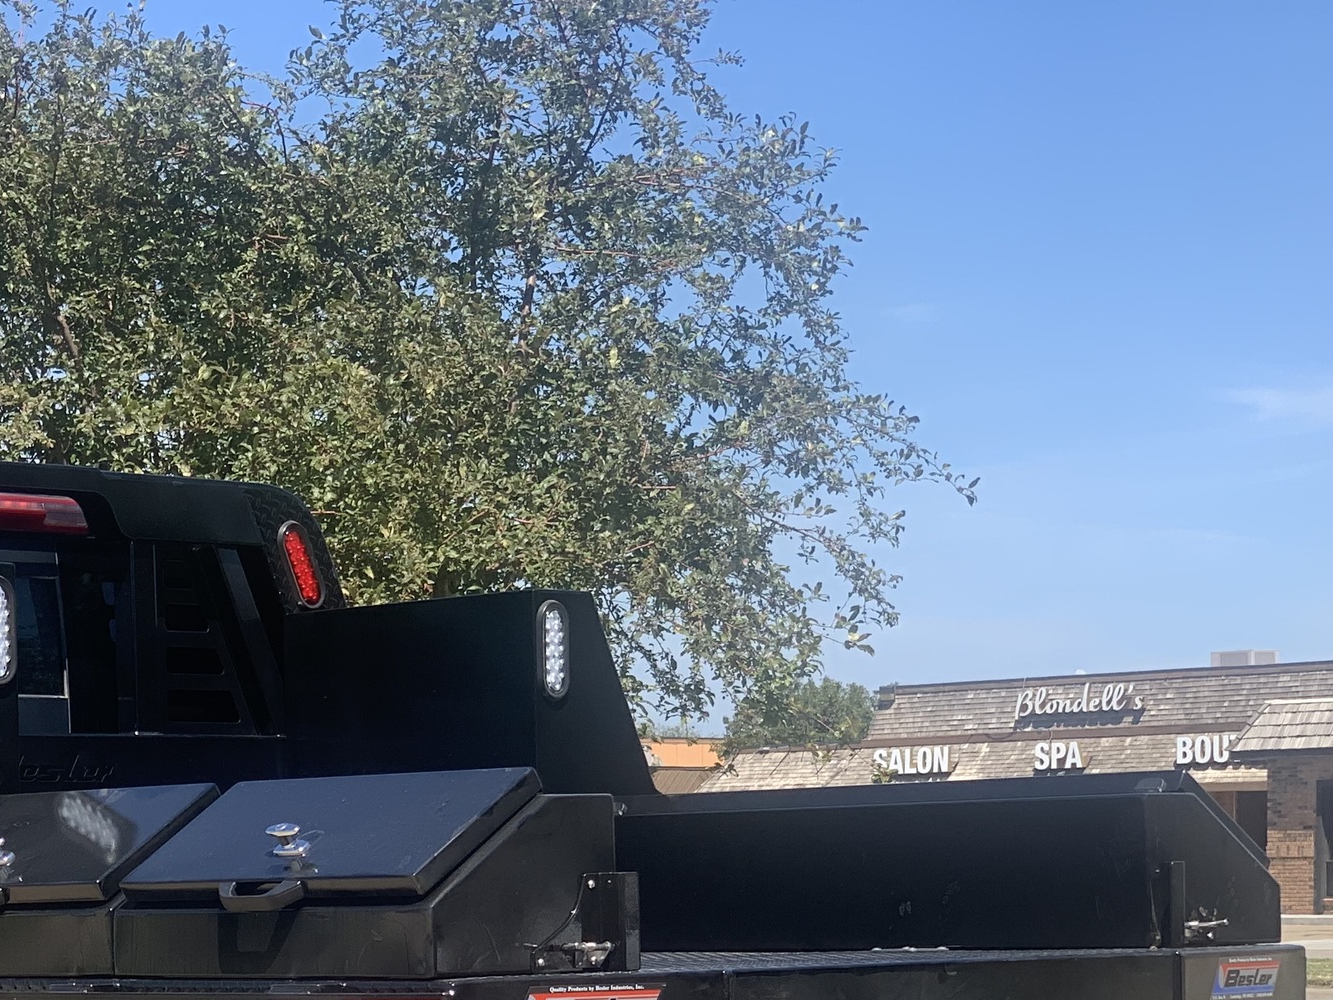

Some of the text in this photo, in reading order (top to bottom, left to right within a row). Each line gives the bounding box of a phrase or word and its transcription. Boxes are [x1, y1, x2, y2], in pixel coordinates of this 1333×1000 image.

[1015, 682, 1144, 720] Blondell's
[873, 746, 950, 775] SALON
[1034, 741, 1083, 770] SPA
[1223, 968, 1273, 987] Besler
